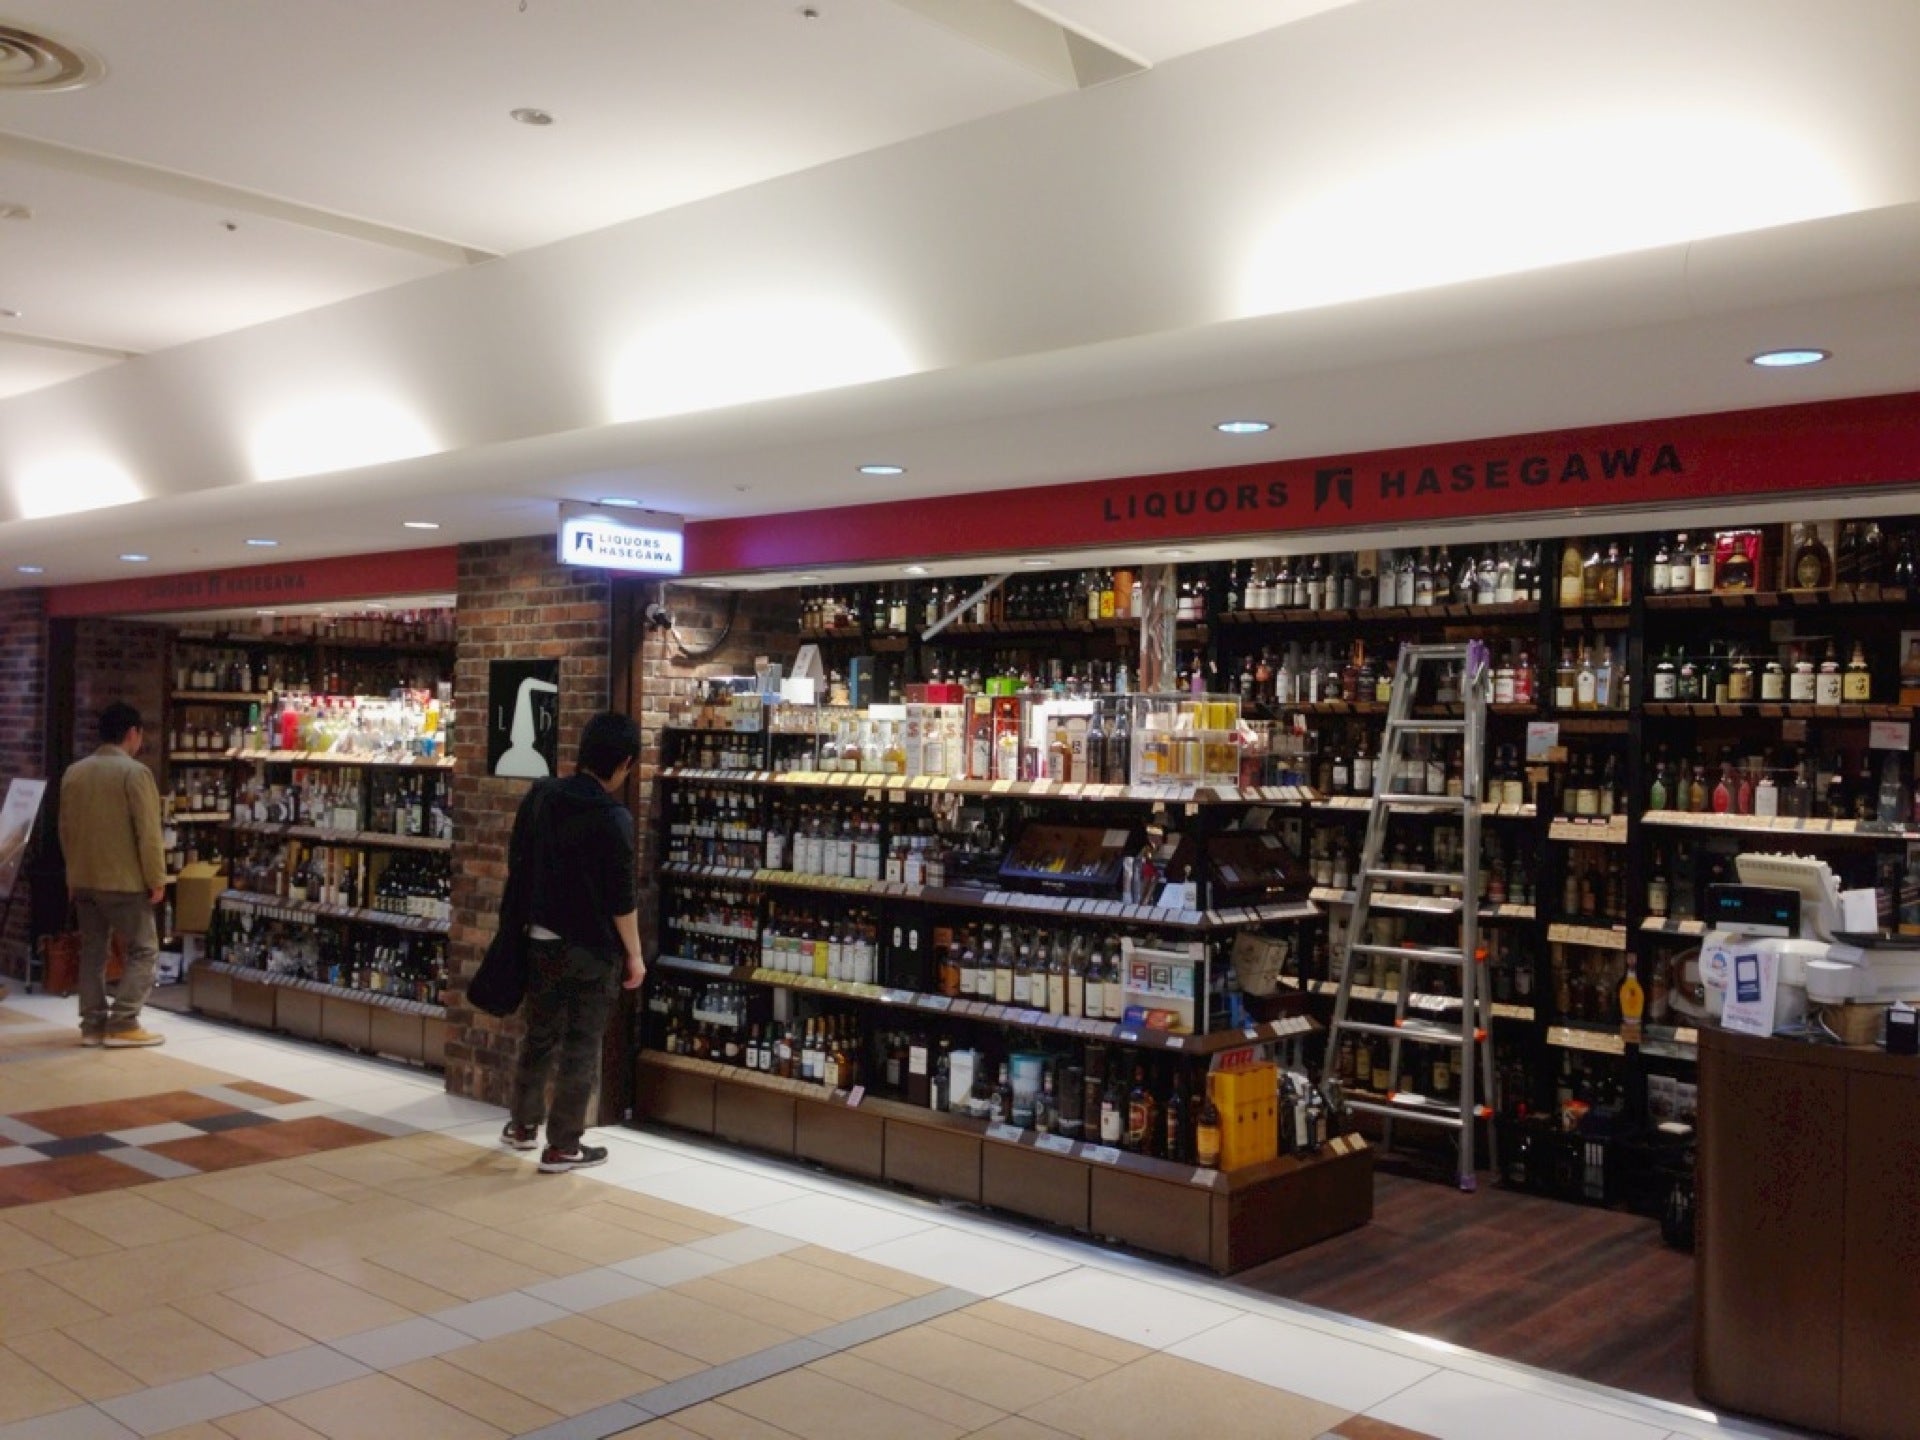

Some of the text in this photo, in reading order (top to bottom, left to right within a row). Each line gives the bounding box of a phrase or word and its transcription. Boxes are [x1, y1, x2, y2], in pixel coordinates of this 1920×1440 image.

[1103, 443, 1684, 522] LIQUORS HASEGAWA
[599, 534, 661, 549] LIQUORS
[599, 546, 673, 563] HASEGAWA
